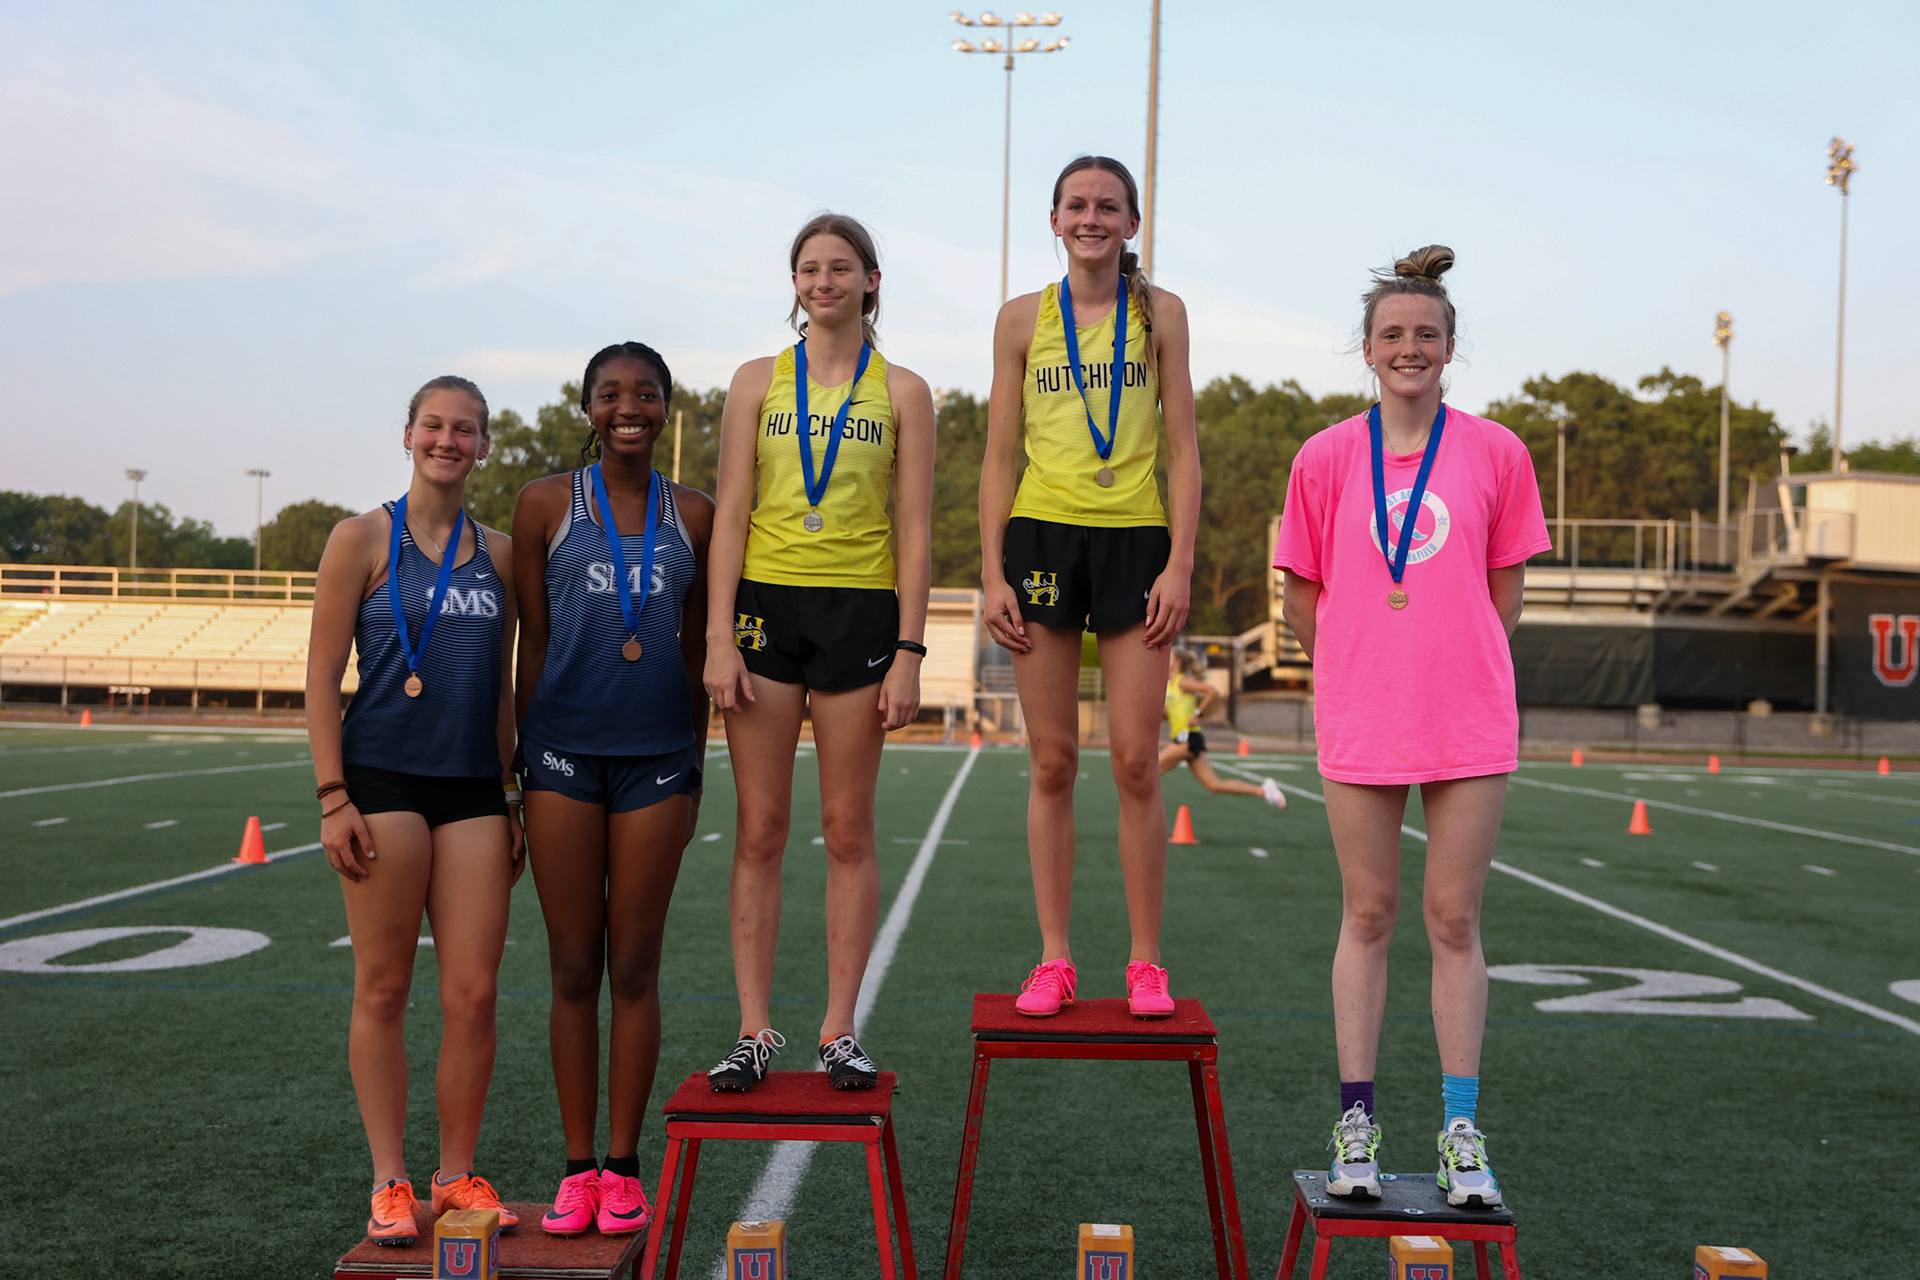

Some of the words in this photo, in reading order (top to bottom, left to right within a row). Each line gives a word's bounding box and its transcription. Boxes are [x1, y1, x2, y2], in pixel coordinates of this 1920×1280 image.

[1037, 361, 1147, 394] HUTHION
[766, 412, 883, 446] HUCHSON
[1400, 489, 1431, 502] AGS
[587, 562, 665, 594] SMS
[1868, 613, 1920, 688] U
[542, 751, 575, 777] SMS
[444, 1242, 476, 1276] U
[739, 1252, 771, 1280] U
